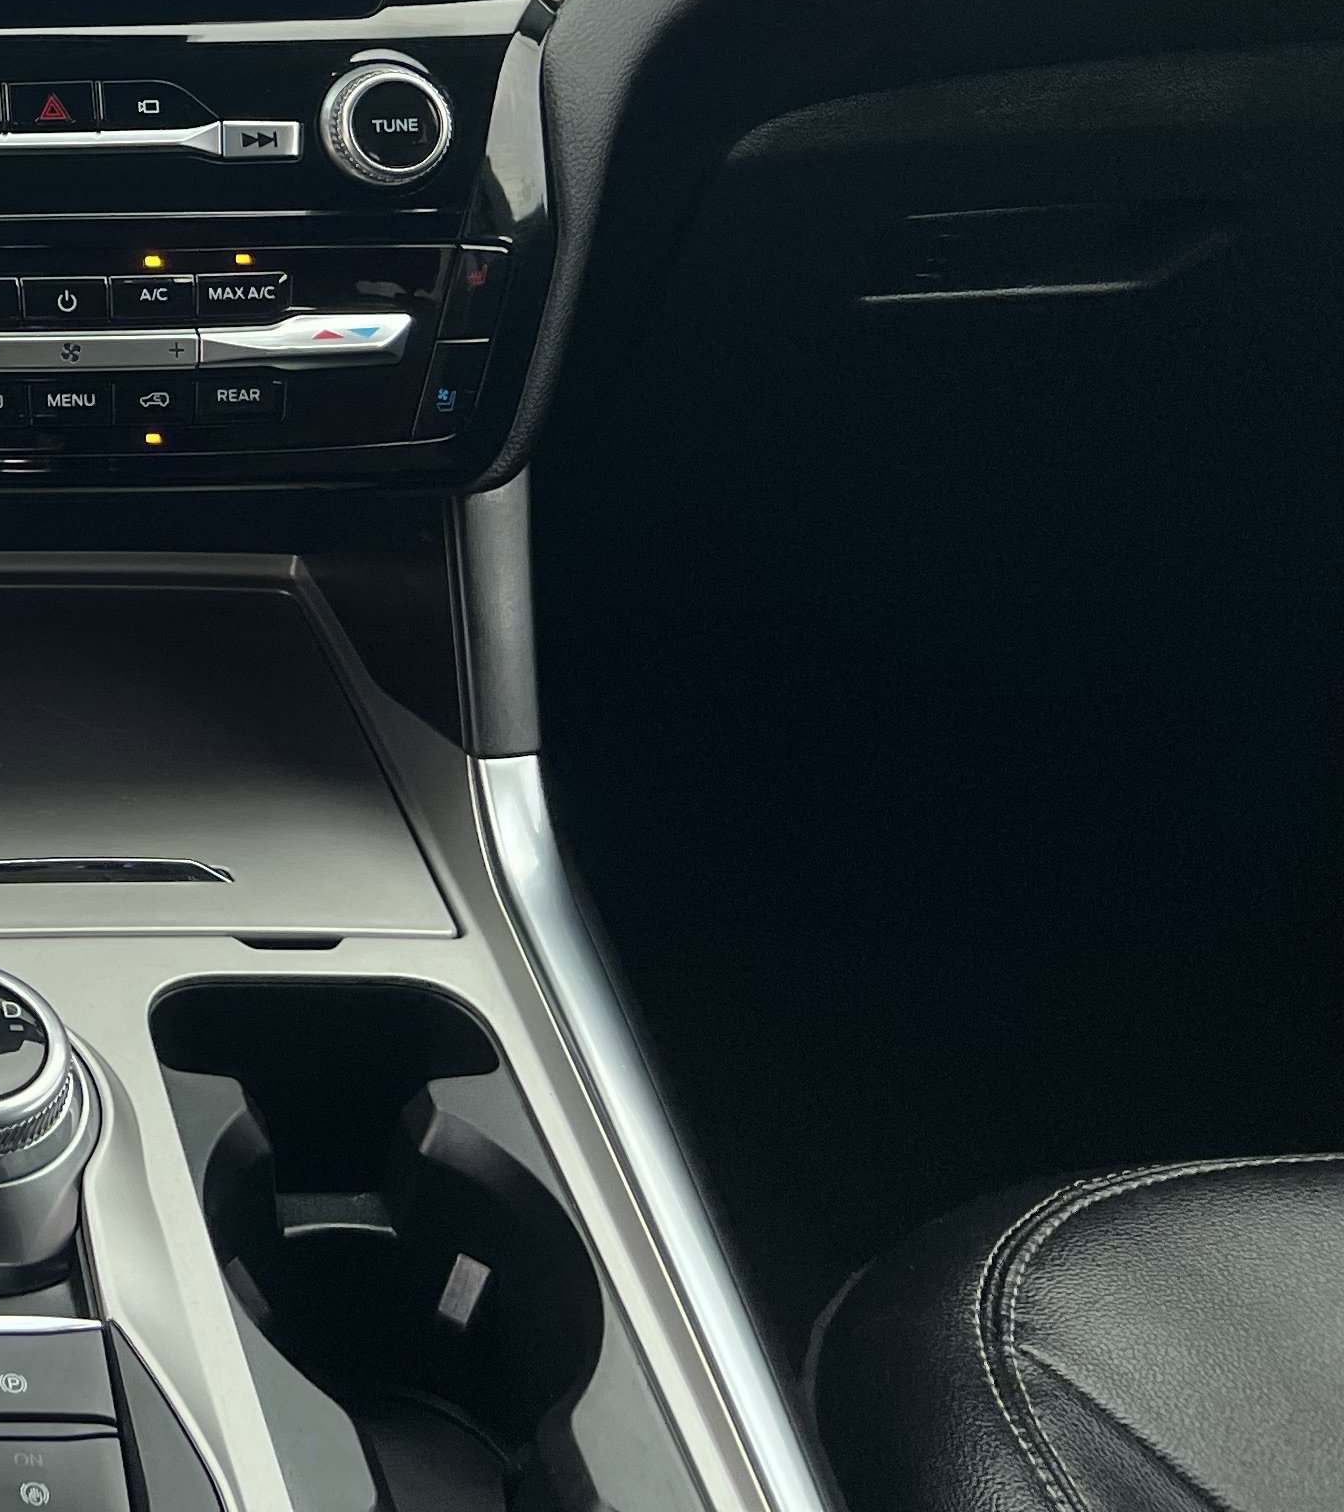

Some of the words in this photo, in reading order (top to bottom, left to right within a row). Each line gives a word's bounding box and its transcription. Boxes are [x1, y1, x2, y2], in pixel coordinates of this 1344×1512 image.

[371, 117, 419, 133] TUNE
[139, 287, 169, 302] A/C
[208, 286, 245, 301] MAX
[247, 285, 276, 300] A/C
[47, 393, 96, 407] MENU
[217, 388, 261, 403] REAR
[1, 1001, 22, 1018] D
